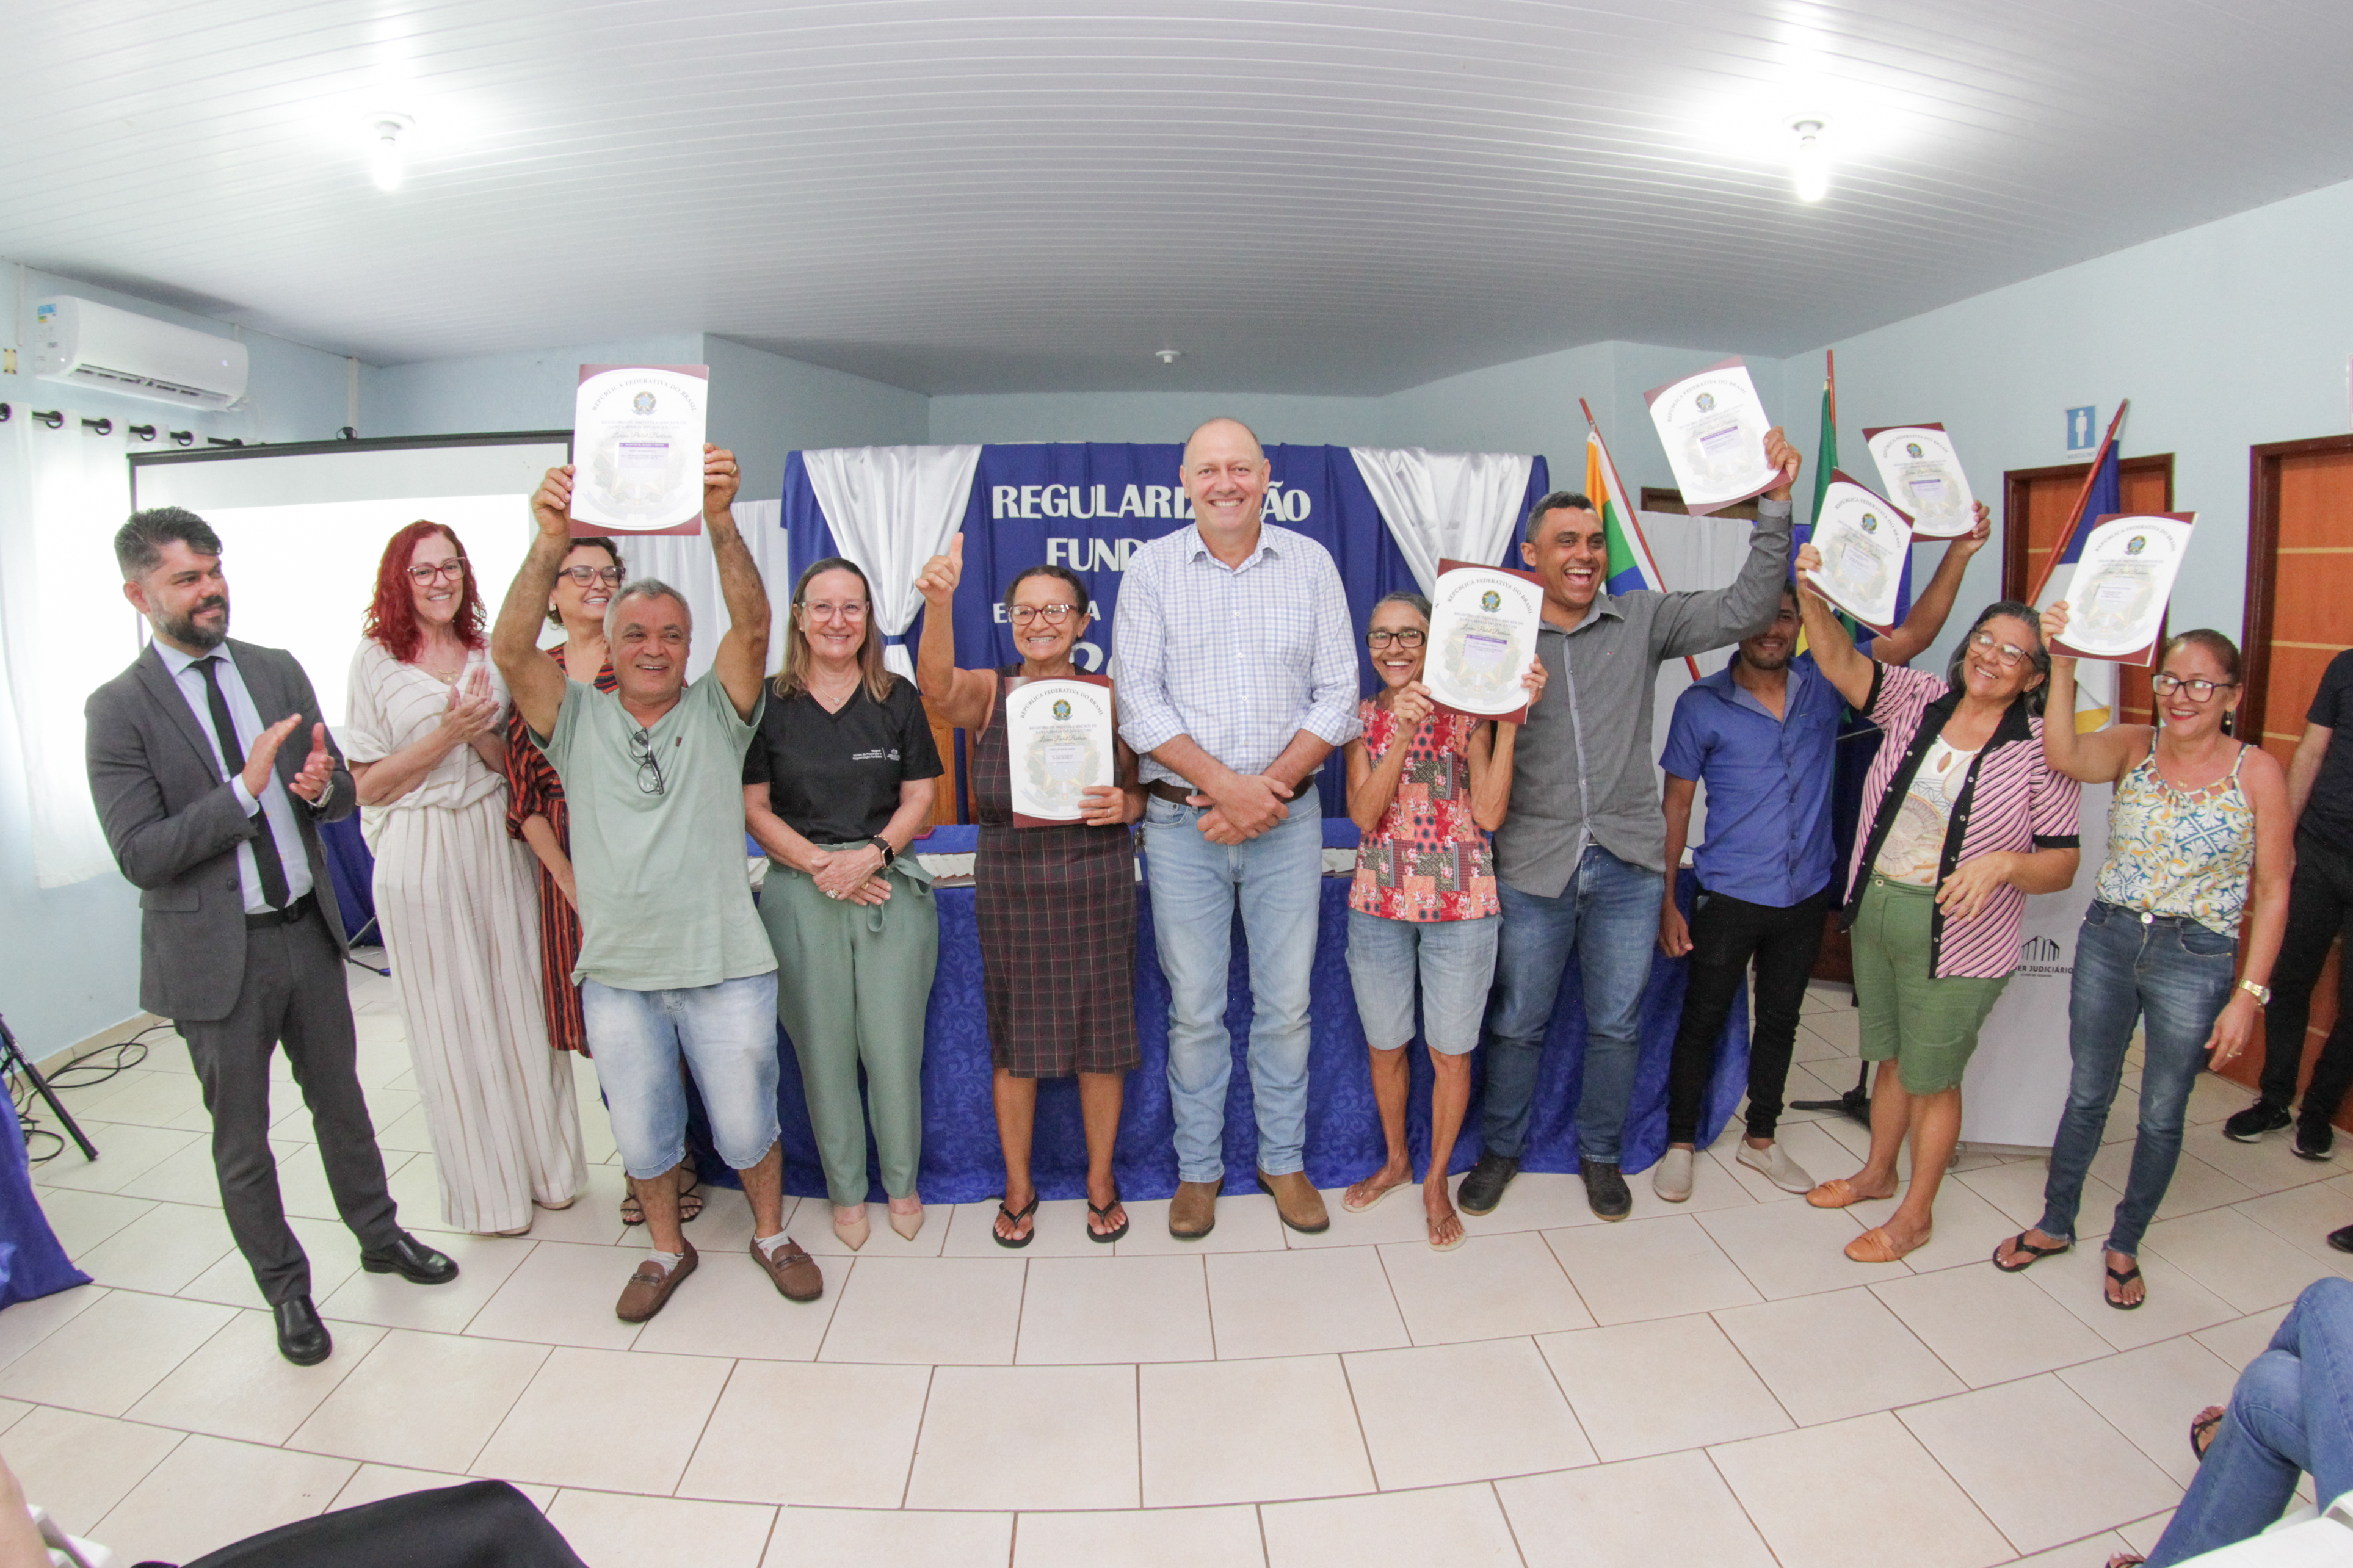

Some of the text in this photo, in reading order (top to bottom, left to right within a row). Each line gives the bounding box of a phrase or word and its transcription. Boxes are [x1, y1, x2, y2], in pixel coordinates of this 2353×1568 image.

[625, 378, 669, 387] FEDERATIVA
[670, 384, 681, 392] DO
[681, 391, 697, 412] BRASIL
[1683, 380, 1717, 395] FEDERATIVA
[1729, 381, 1747, 394] BRASIL
[993, 481, 1311, 522] REGULARIÃO
[1860, 498, 1888, 519] FEDERATIVA
[1887, 519, 1894, 528] DO
[1046, 538, 1156, 572] FUND
[2166, 534, 2176, 552] BRASIL
[1448, 578, 1533, 615] REPÚBLICA FEDERATIVA DO BRASIL
[1020, 693, 1043, 719] REPÚBLICA
[1089, 698, 1104, 717] BRASIL
[2029, 965, 2074, 974] JUDICIÁRIO
